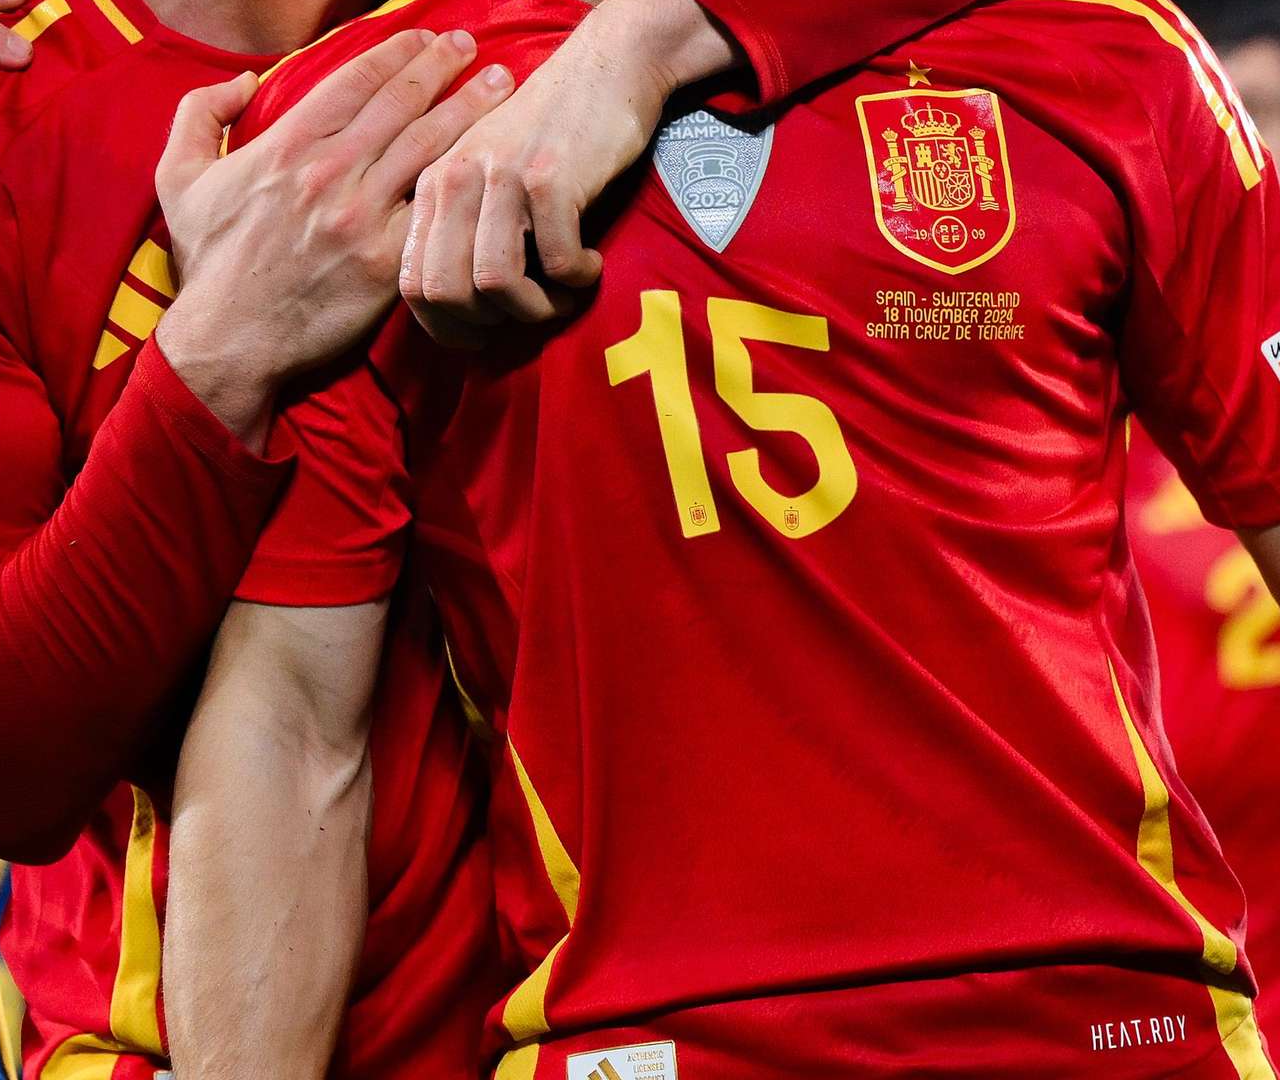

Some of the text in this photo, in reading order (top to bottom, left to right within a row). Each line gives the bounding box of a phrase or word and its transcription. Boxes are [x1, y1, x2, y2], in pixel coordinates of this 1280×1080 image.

[688, 191, 740, 209] 2024
[876, 290, 916, 306] SPAIN
[932, 292, 1020, 308] SWITZERLAND
[884, 307, 1013, 324] 18 NOVEMBER 2024
[866, 323, 1025, 340] SANTA CRUZ DE TENERIFE
[604, 289, 858, 539] 15
[1091, 1014, 1185, 1051] HEAT.RDY
